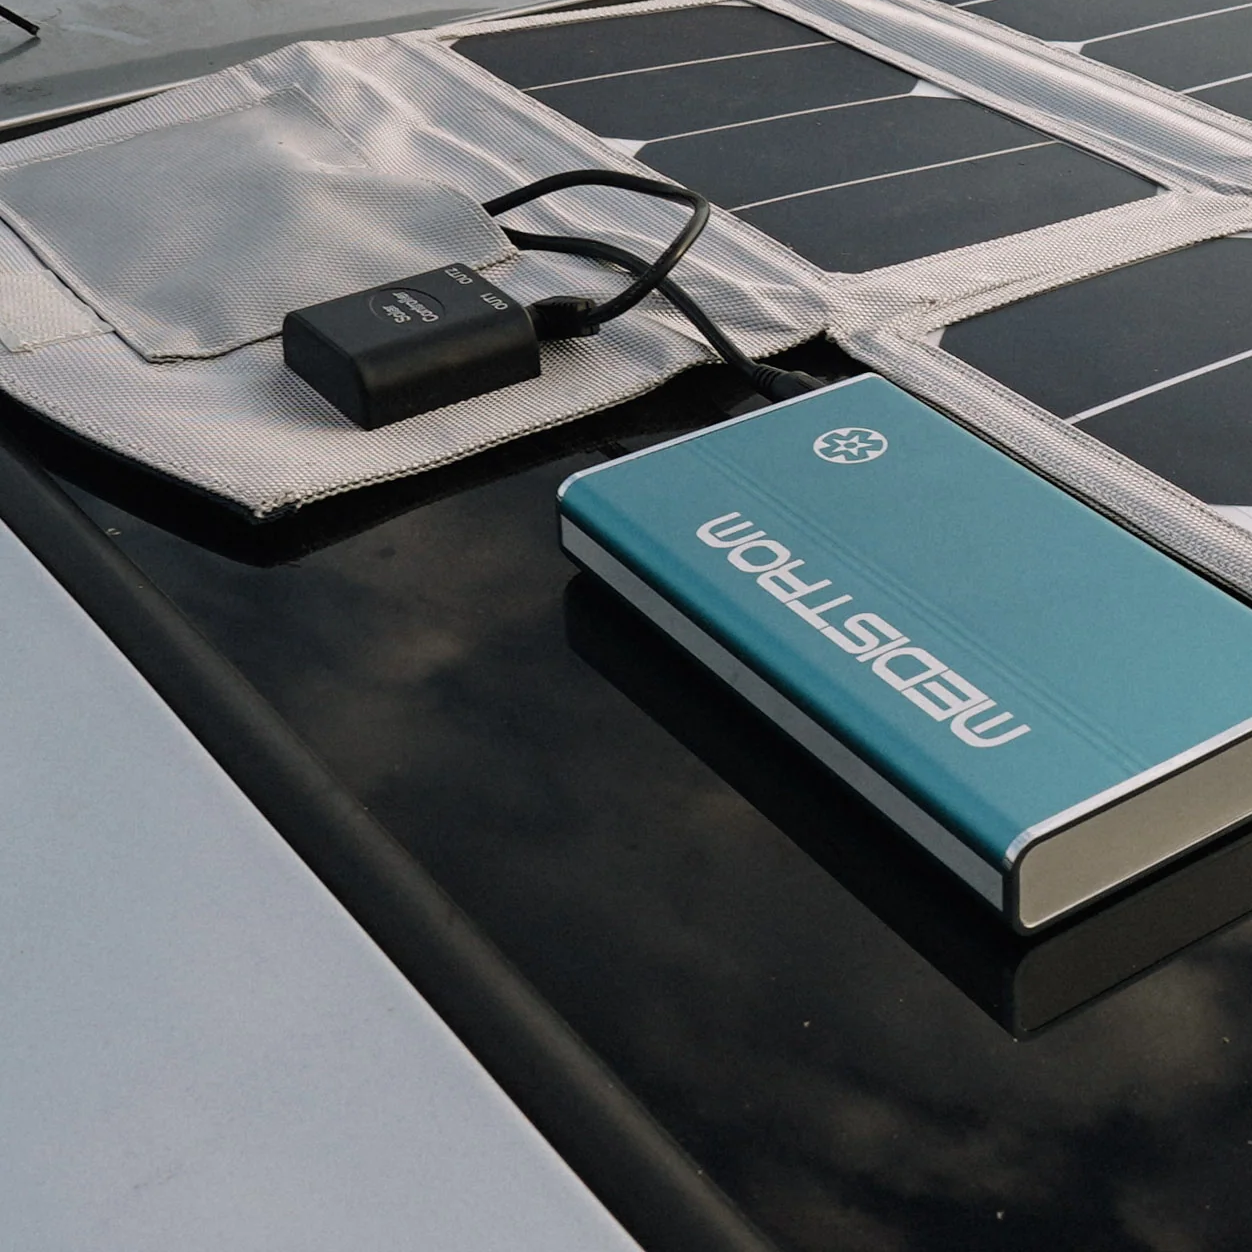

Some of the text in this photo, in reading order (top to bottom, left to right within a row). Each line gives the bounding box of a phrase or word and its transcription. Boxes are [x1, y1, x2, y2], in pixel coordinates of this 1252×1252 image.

[445, 268, 473, 285] OUT2
[392, 291, 439, 322] Controller
[480, 293, 509, 310] OUT1
[382, 304, 411, 324] Solar
[696, 511, 1030, 748] MEDISTROM
